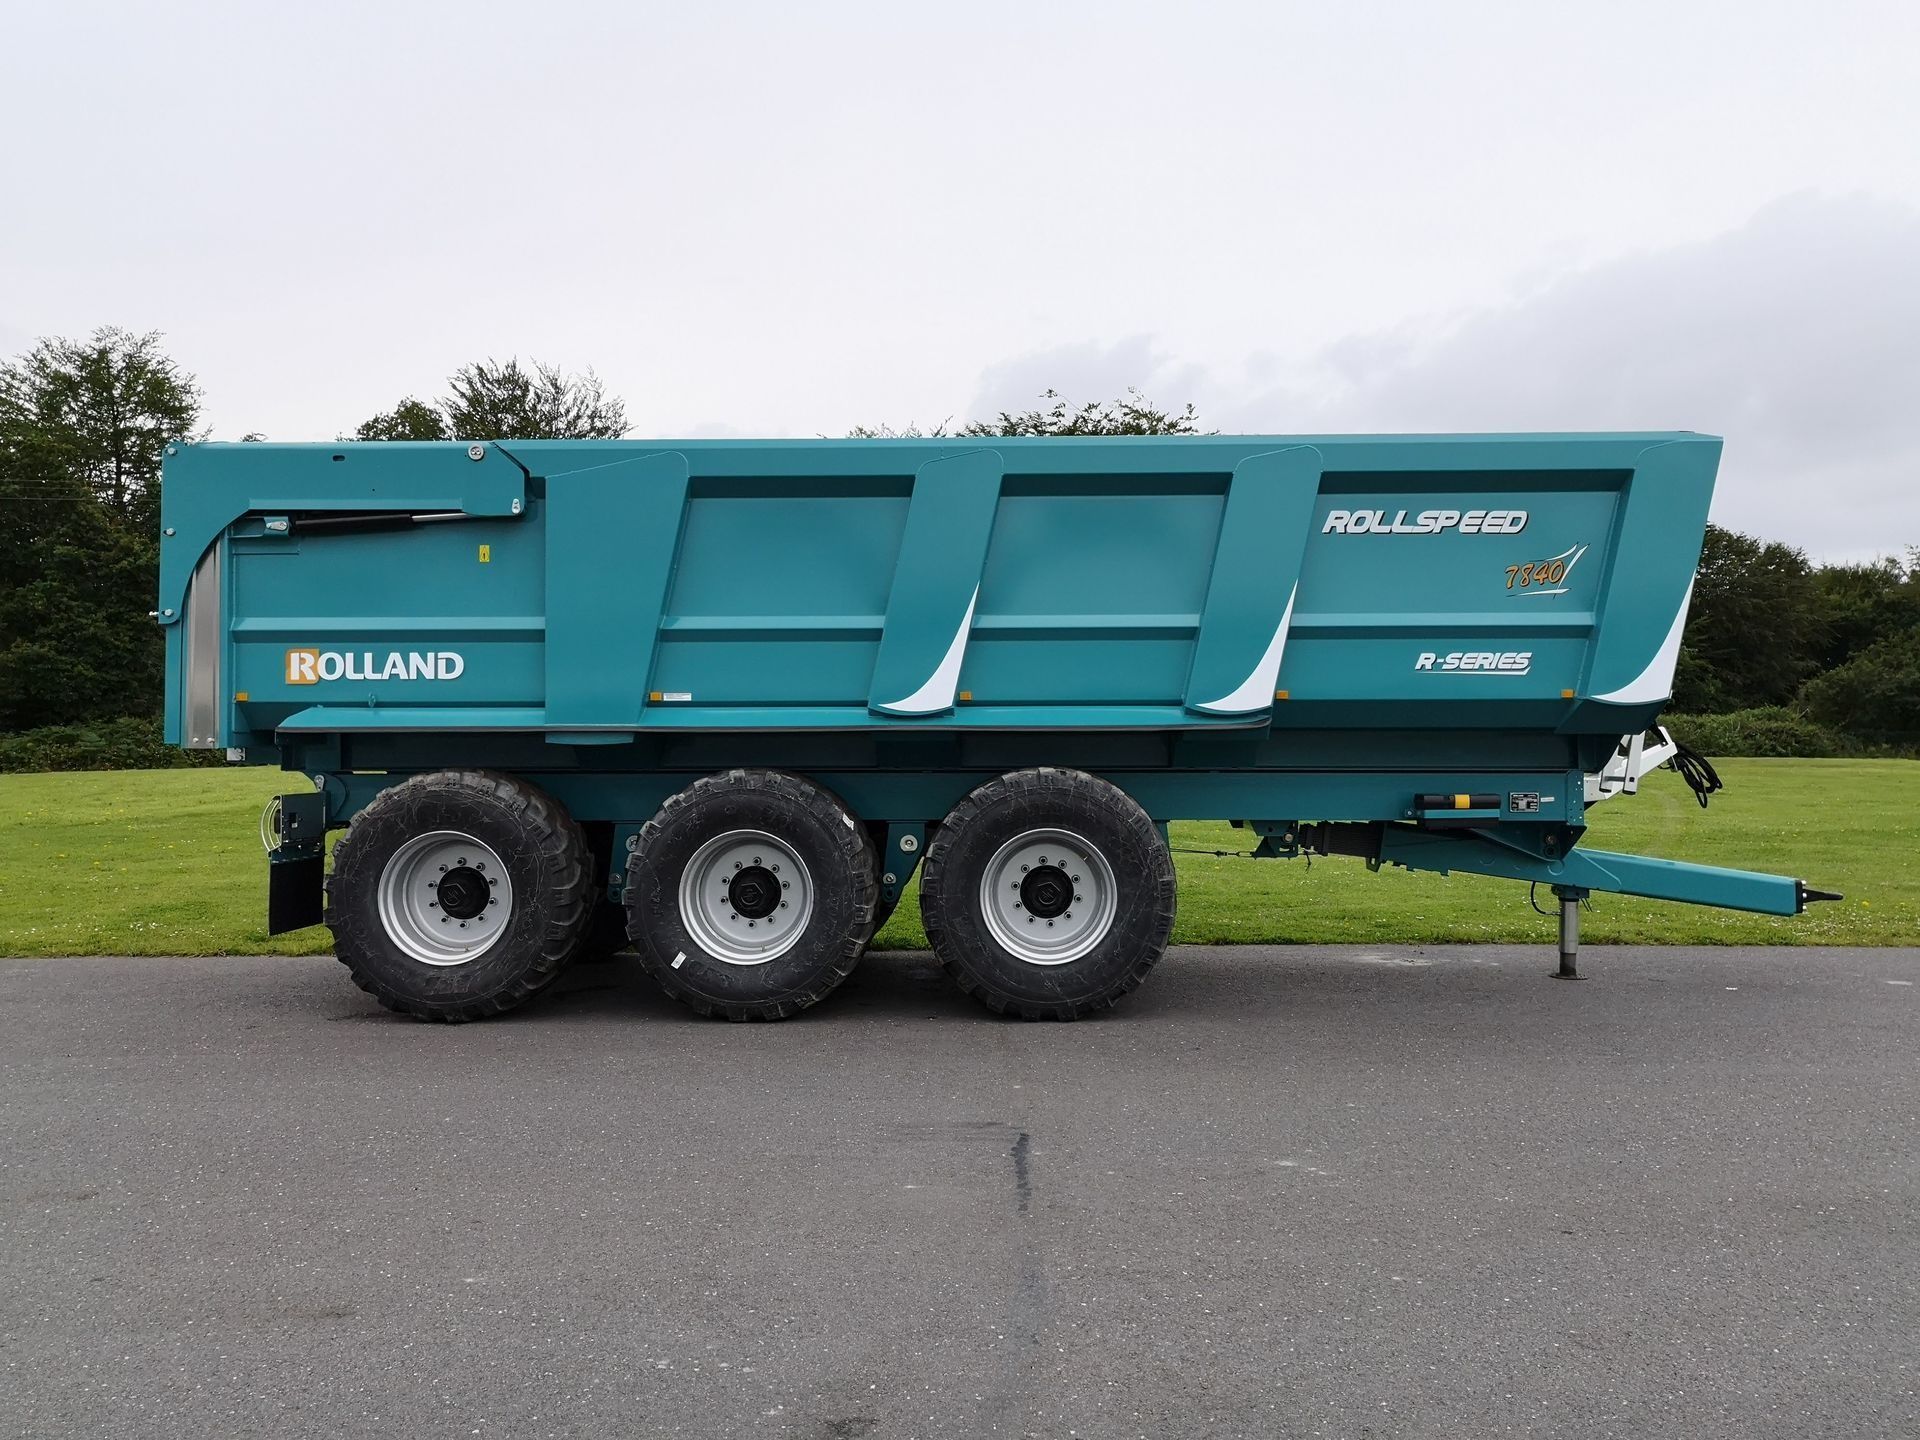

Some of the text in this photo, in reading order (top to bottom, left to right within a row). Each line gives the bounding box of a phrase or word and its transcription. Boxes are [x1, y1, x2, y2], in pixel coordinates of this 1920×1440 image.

[1322, 510, 1528, 534] ROLLSPEED
[1505, 560, 1565, 588] 7840
[289, 651, 465, 681] ROLLAND
[1415, 652, 1533, 670] R-SERIES
